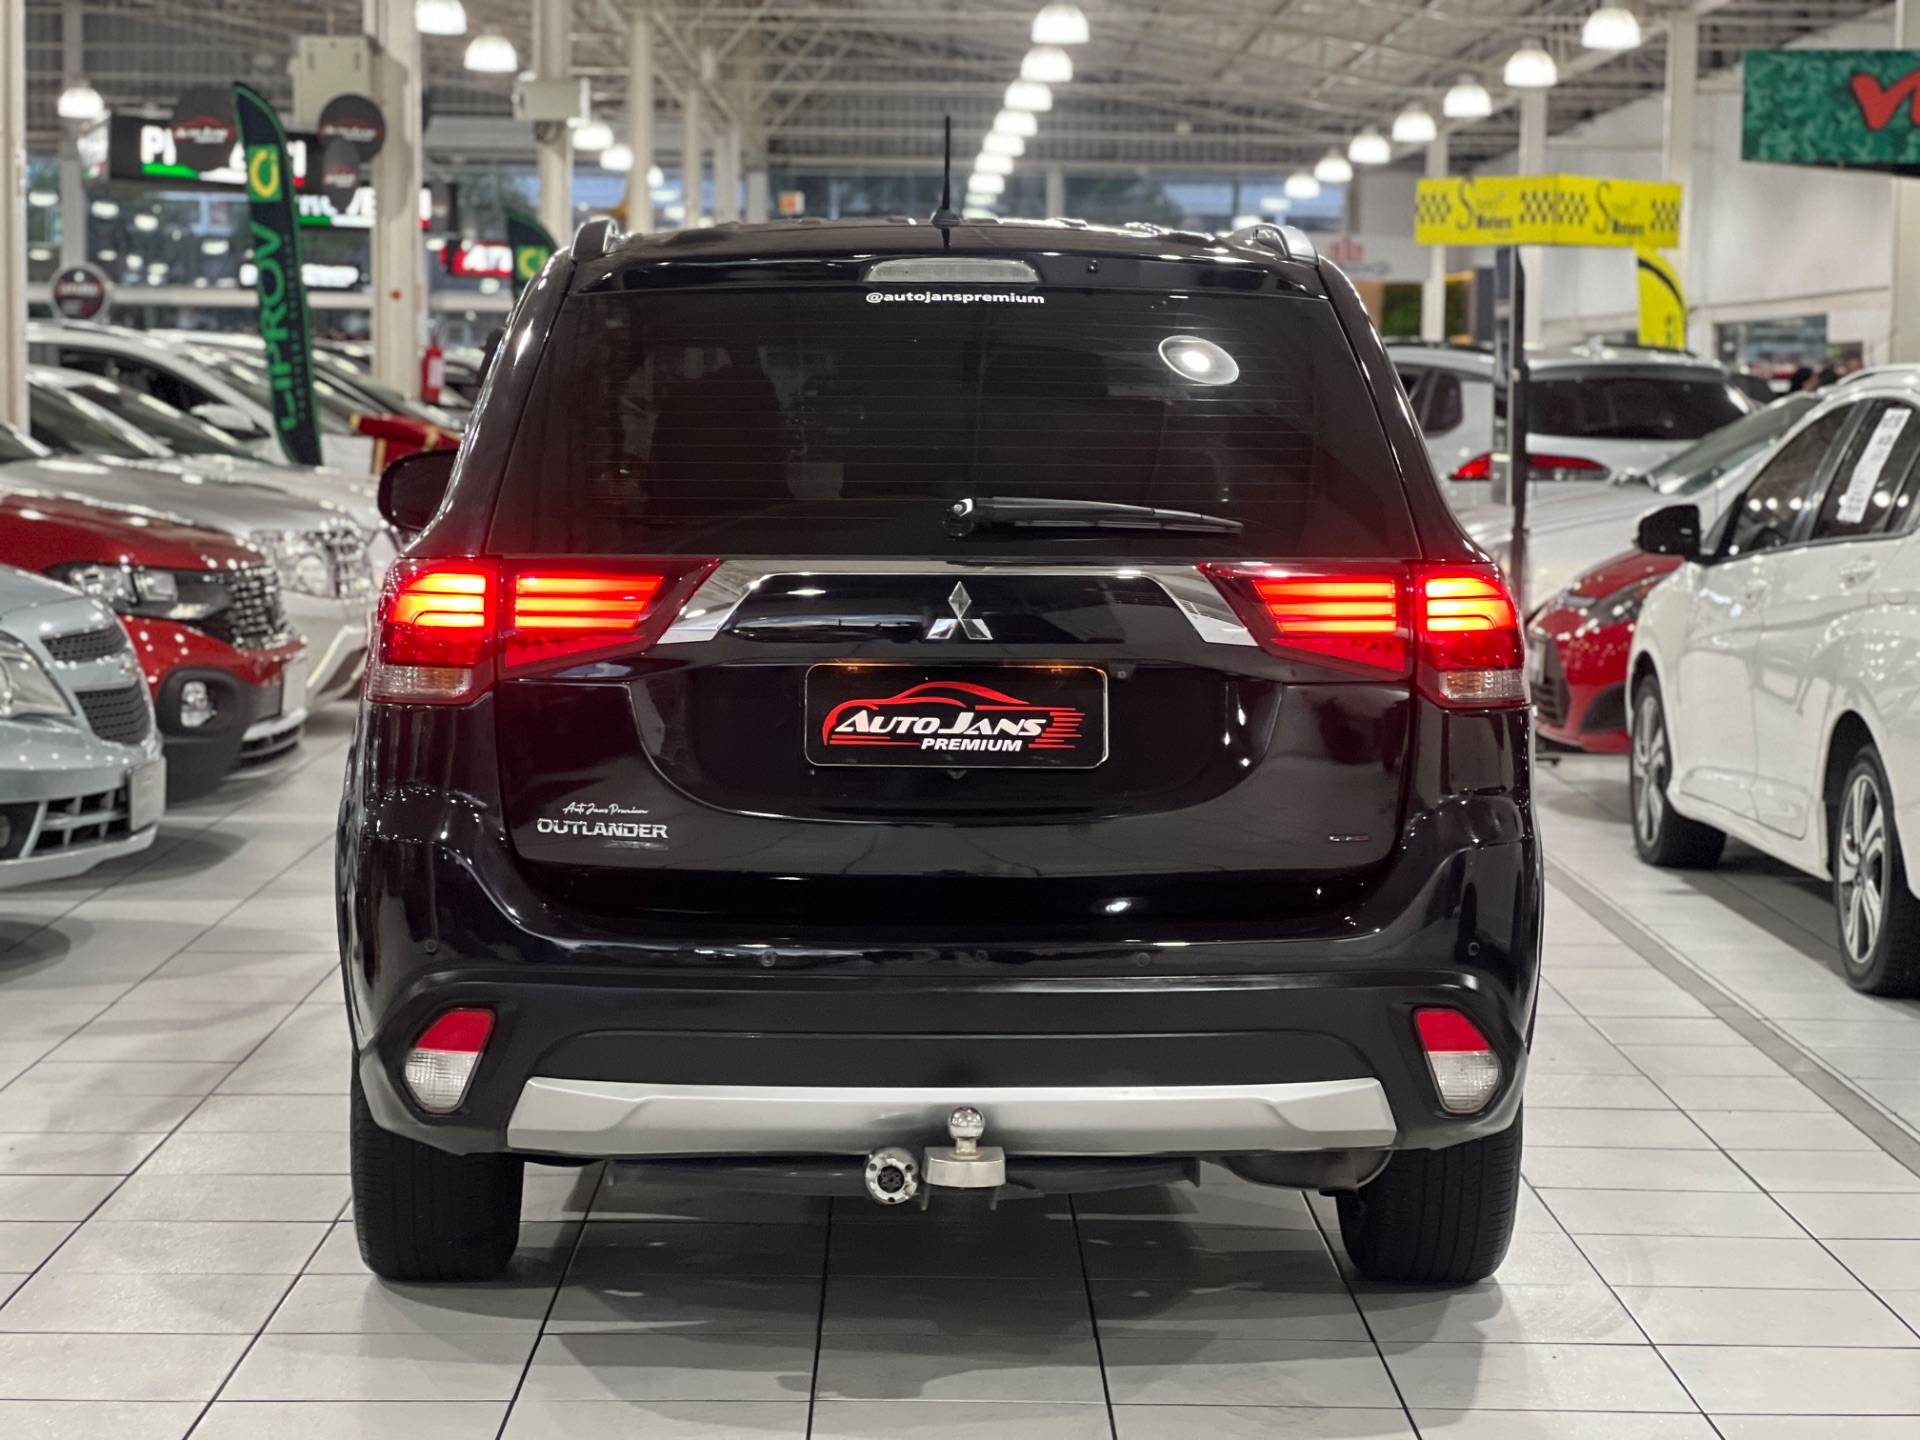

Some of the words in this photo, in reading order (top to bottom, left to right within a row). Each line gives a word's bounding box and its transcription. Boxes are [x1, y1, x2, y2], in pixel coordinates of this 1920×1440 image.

[866, 291, 1045, 304] @autojanspremium
[834, 709, 940, 734] AUTO
[942, 711, 1047, 736] JANS
[920, 738, 1023, 752] PREMIUM
[609, 803, 649, 815] Premium
[537, 817, 669, 839] OUTLANDER
